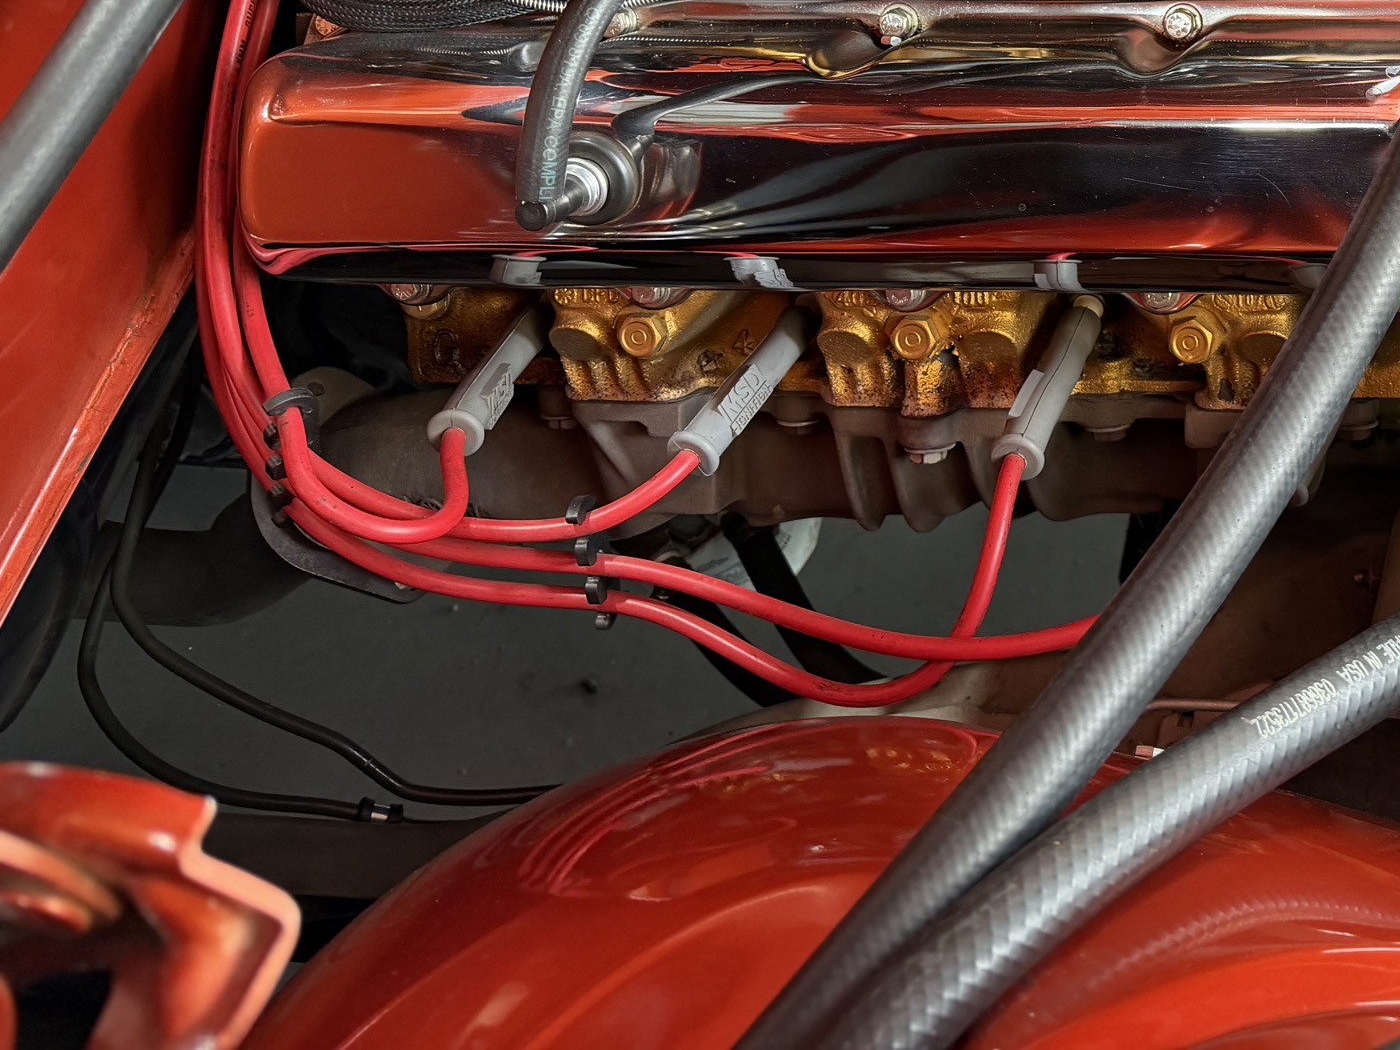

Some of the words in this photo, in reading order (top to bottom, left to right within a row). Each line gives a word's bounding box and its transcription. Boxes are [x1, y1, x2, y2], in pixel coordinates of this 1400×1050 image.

[549, 95, 568, 130] EPA
[718, 363, 767, 423] MSD
[1336, 656, 1367, 688] USA
[1366, 650, 1383, 673] IN
